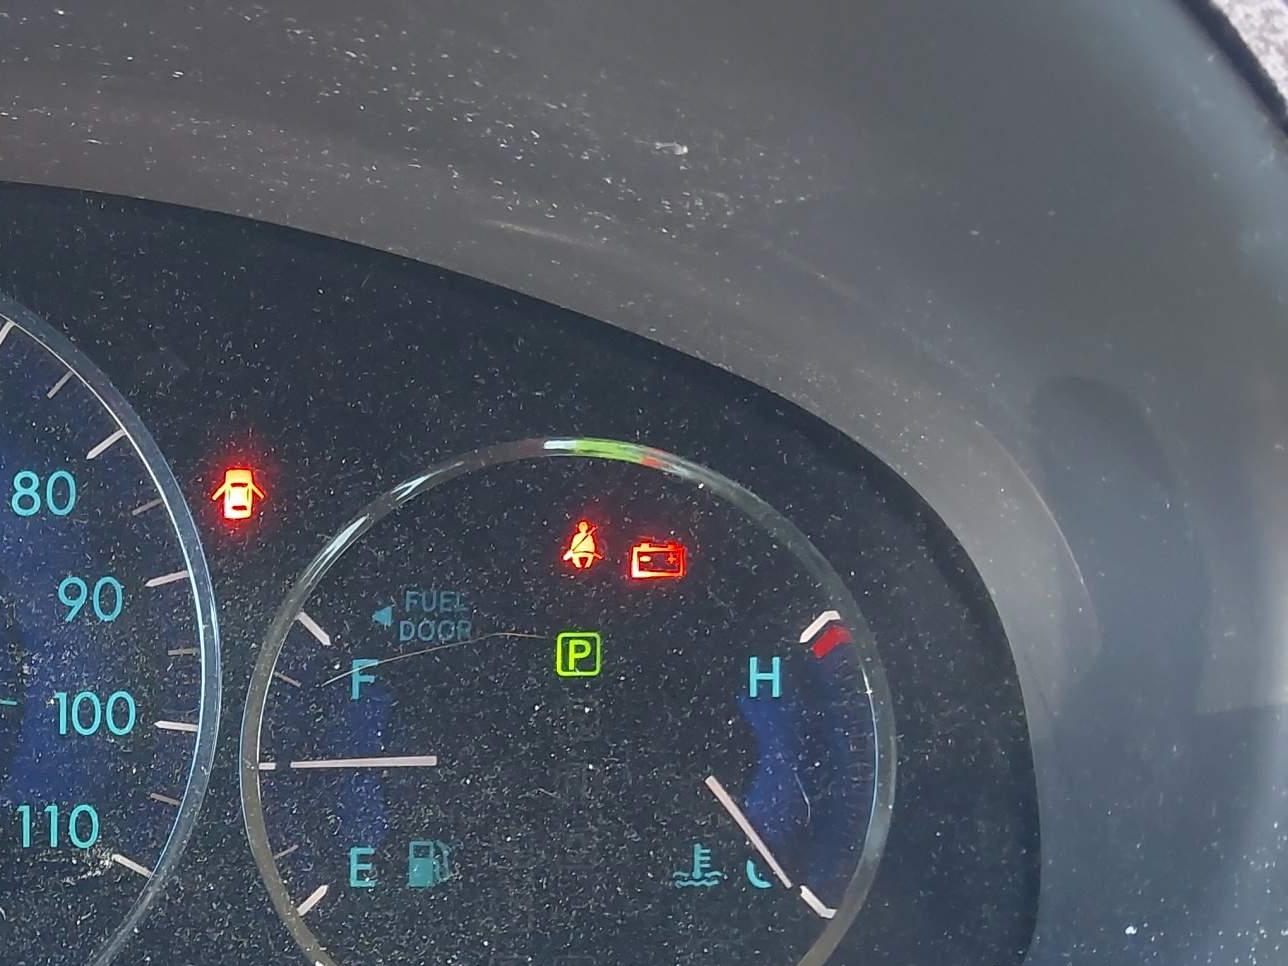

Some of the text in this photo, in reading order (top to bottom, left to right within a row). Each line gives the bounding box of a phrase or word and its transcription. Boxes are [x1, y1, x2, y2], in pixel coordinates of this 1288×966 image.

[11, 471, 77, 516] 80
[58, 577, 123, 622] 90
[406, 591, 466, 613] FUEL
[399, 621, 471, 641] DOOR
[568, 642, 590, 668] P
[352, 659, 378, 699] F
[749, 657, 780, 696] H
[55, 692, 135, 737] 100
[19, 804, 99, 848] 110
[350, 846, 375, 886] E
